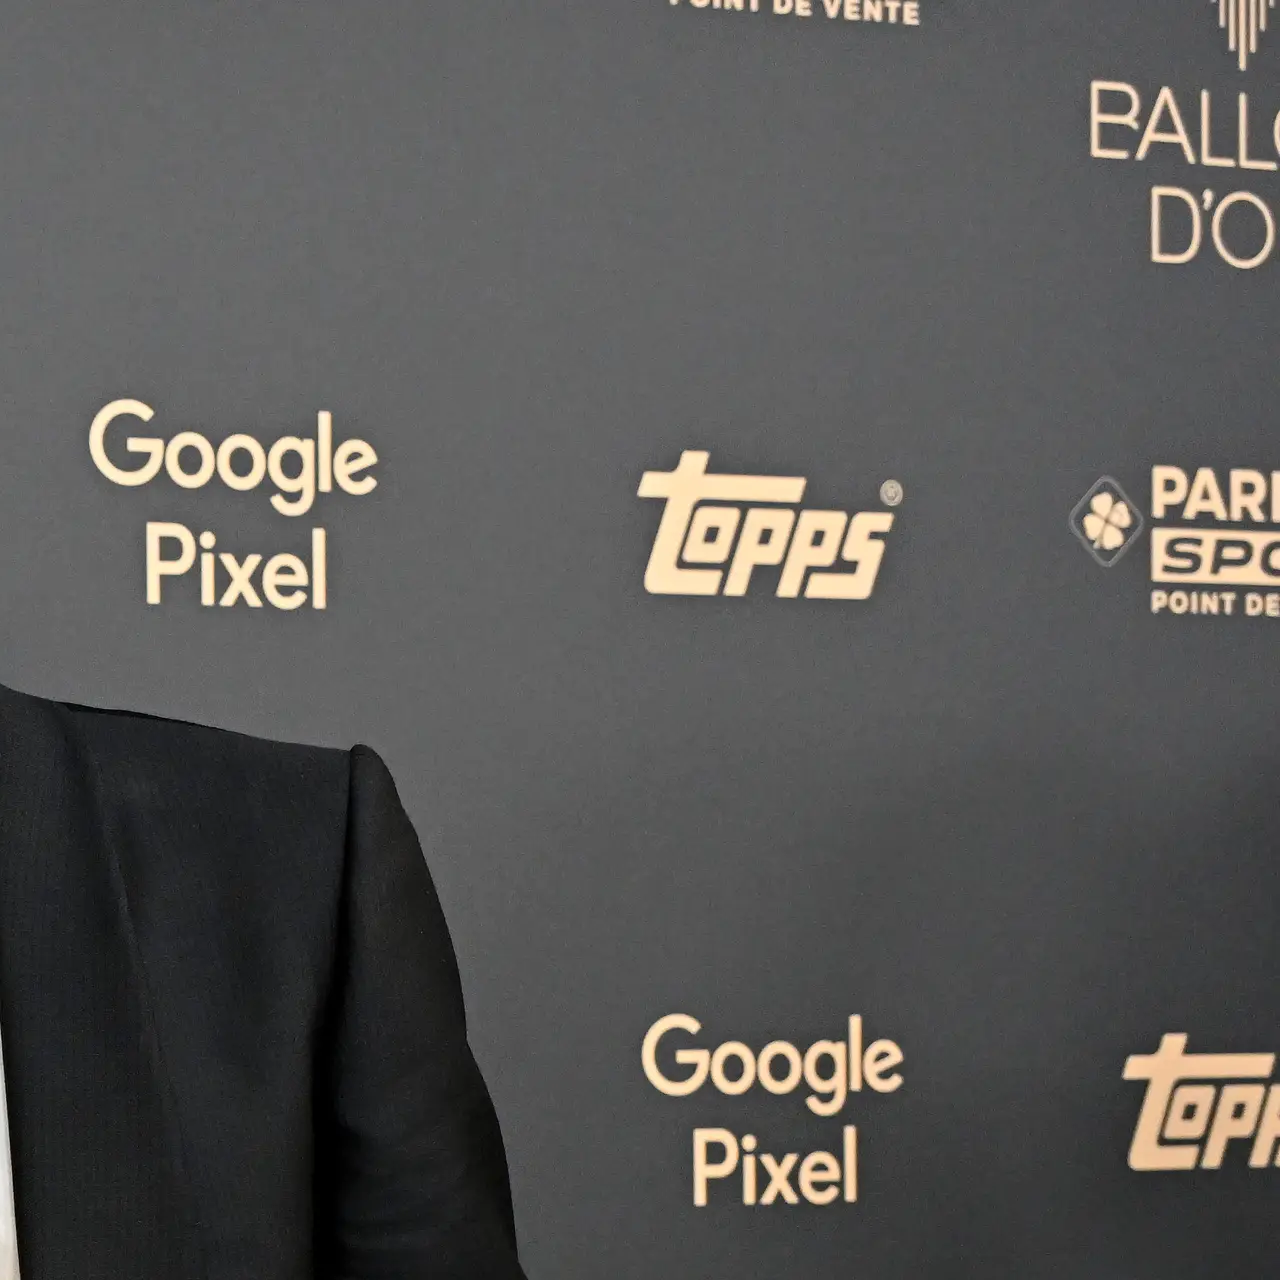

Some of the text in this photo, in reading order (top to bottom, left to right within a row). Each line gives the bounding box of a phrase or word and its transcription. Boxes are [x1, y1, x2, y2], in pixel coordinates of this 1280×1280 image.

[823, 0, 920, 26] VENTE
[1091, 80, 1280, 170] BALL
[89, 398, 378, 516] Google
[146, 521, 327, 610] Pixel
[1151, 590, 1237, 614] POINT
[641, 1013, 904, 1116] Google
[692, 1125, 857, 1206] Pixel
